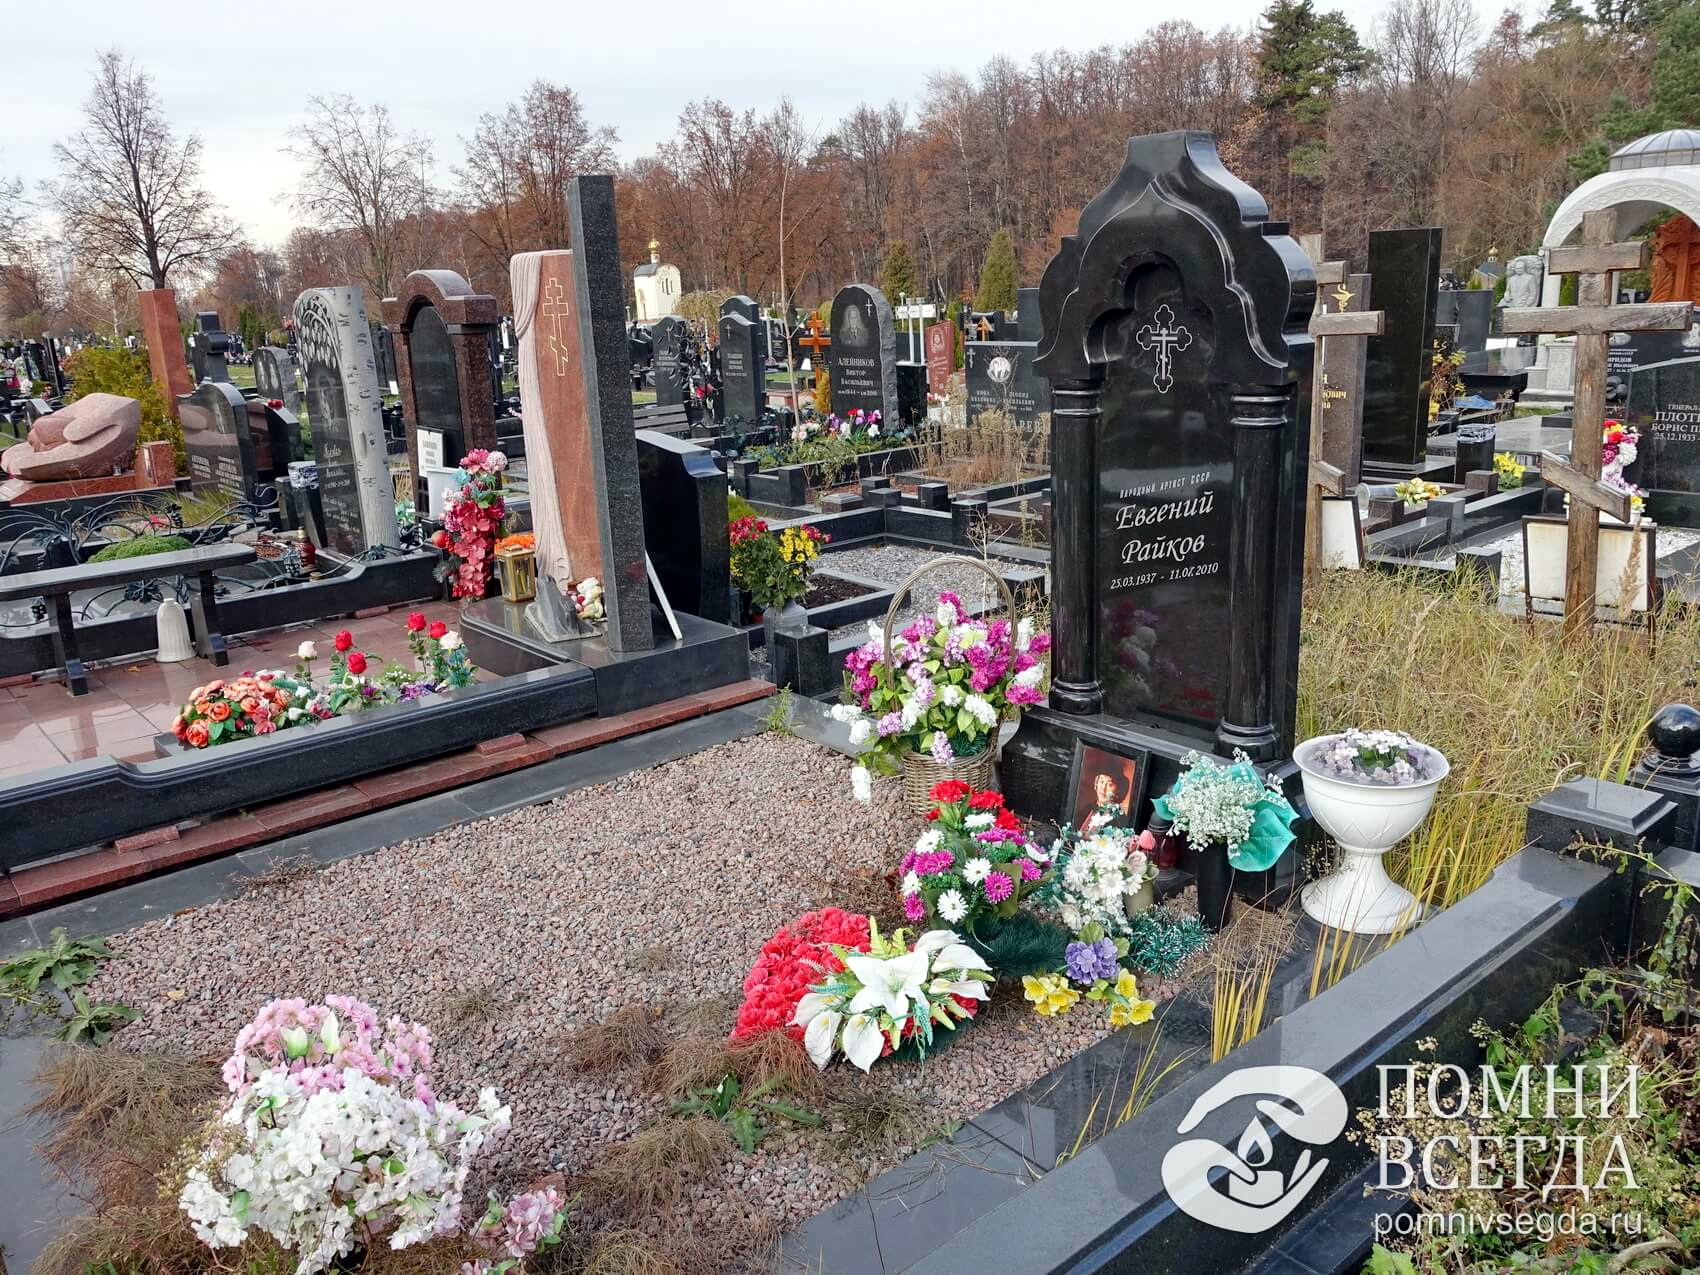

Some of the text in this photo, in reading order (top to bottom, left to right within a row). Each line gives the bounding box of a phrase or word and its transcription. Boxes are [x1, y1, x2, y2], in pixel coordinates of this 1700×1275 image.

[1651, 423, 1688, 433] БОРИС
[1159, 477, 1186, 491] АРТИСТ
[1190, 471, 1211, 485] СССР
[1115, 490, 1215, 530] Евгений
[1121, 534, 1206, 565] Райков
[1110, 572, 1157, 590] 25.03.1937
[1169, 562, 1219, 581] 11.07.2010
